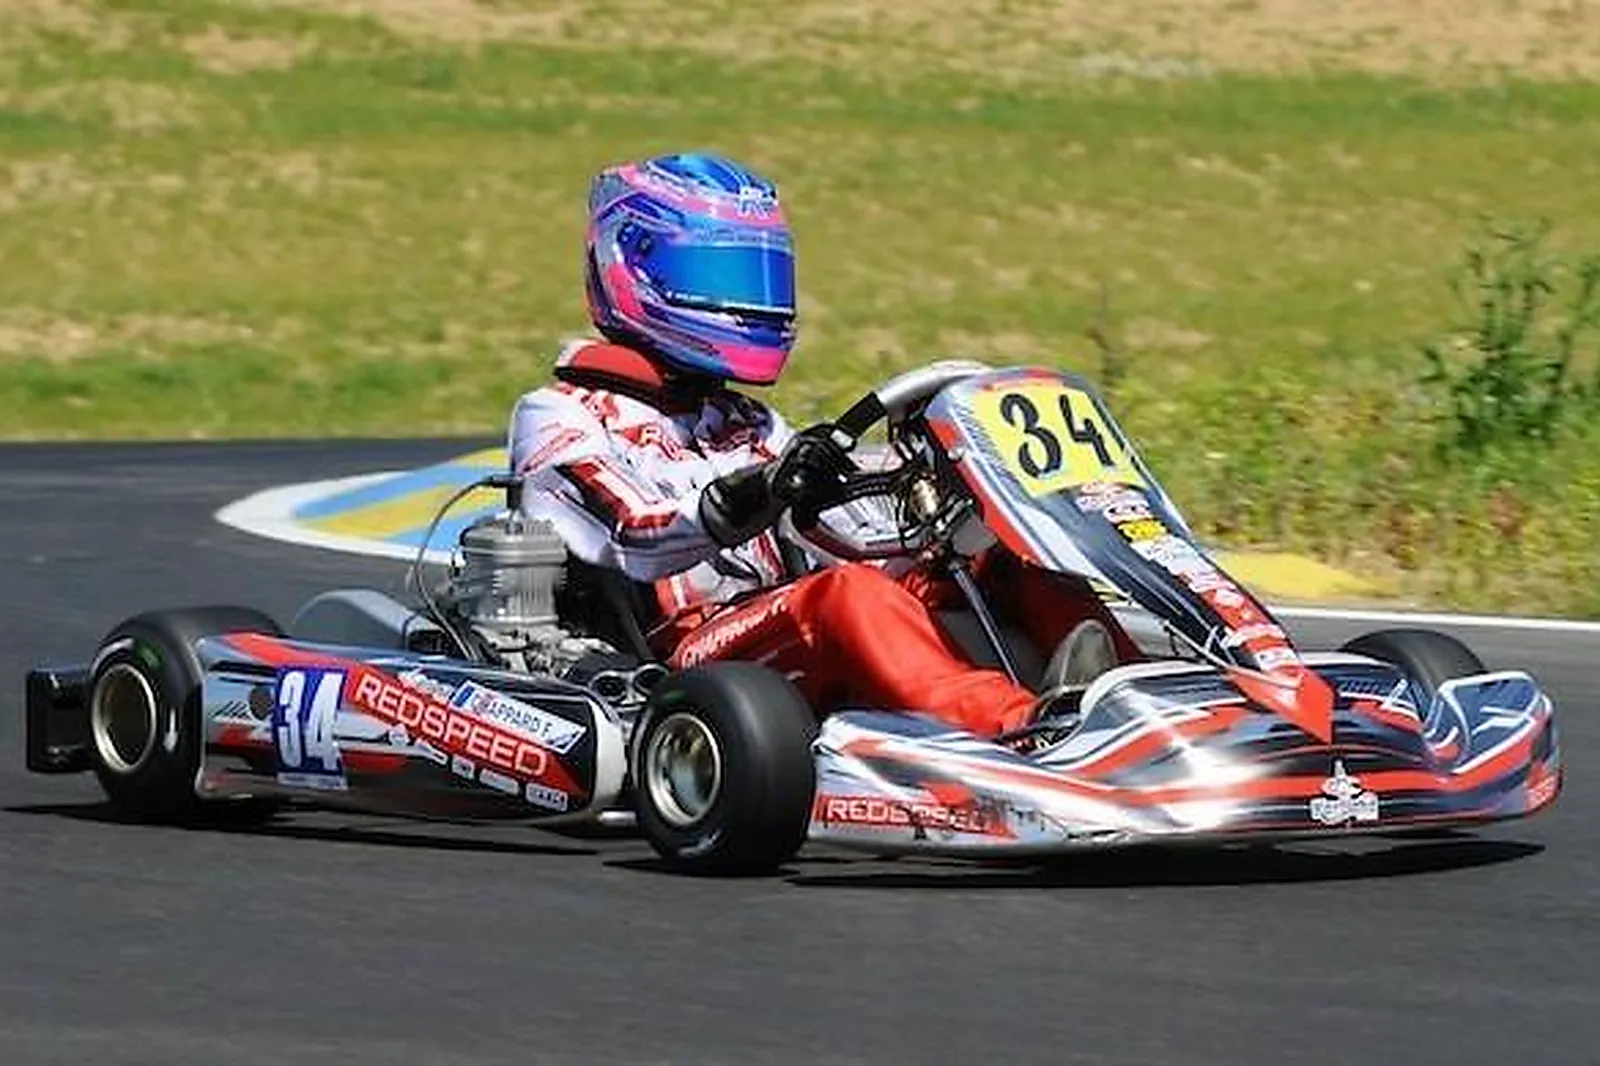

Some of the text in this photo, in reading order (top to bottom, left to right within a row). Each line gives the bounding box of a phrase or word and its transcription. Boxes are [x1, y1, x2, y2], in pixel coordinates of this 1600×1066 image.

[1001, 393, 1115, 478] 34
[279, 671, 343, 771] 34
[355, 673, 547, 776] REDSPEED
